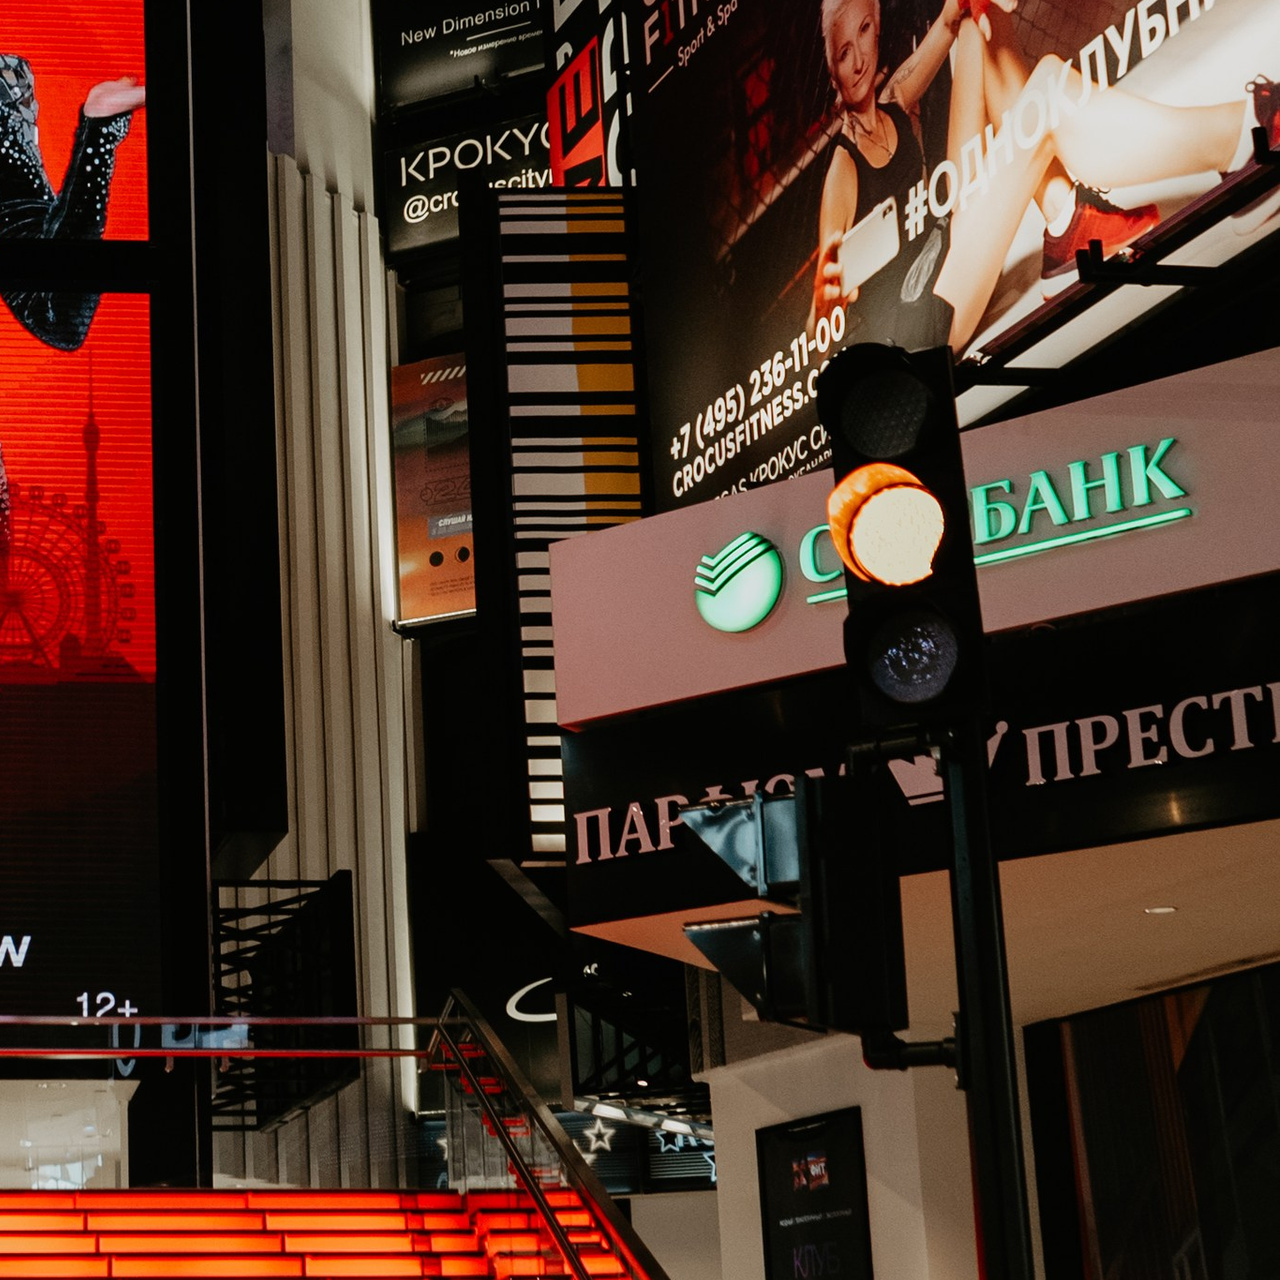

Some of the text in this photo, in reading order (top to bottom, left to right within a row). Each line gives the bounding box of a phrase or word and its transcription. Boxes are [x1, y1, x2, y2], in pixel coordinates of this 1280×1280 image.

[401, 26, 437, 46] New
[442, 1, 530, 35] Dimension
[677, 29, 705, 67] Sport
[707, 15, 715, 36] &
[670, 305, 845, 460] +7 (495) 236-11-00
[76, 991, 138, 1017] 12+
